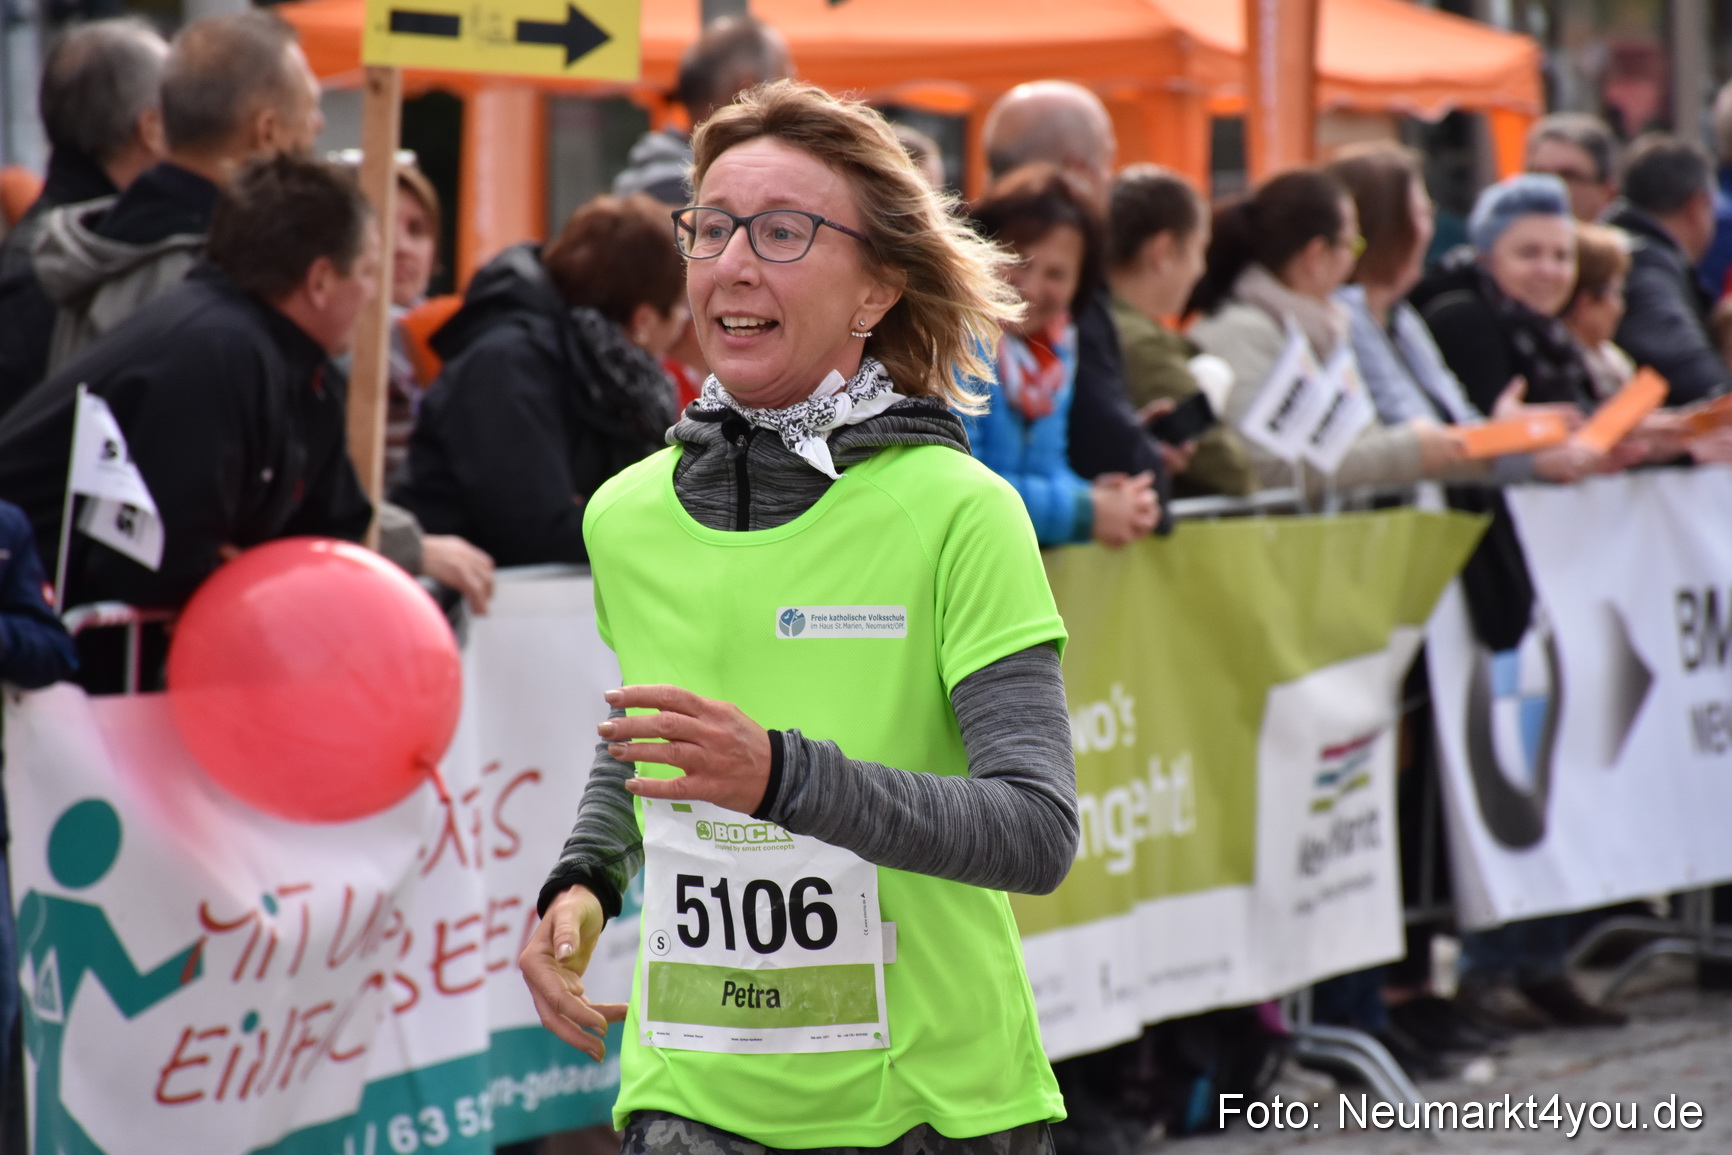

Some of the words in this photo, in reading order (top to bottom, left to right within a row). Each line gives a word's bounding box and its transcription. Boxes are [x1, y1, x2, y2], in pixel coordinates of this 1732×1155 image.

[713, 821, 793, 844] BOCK
[715, 843, 733, 851] inspired
[676, 873, 838, 954] 5106
[657, 936, 665, 950] S
[721, 980, 781, 1008] Petra
[388, 1105, 451, 1154] 63
